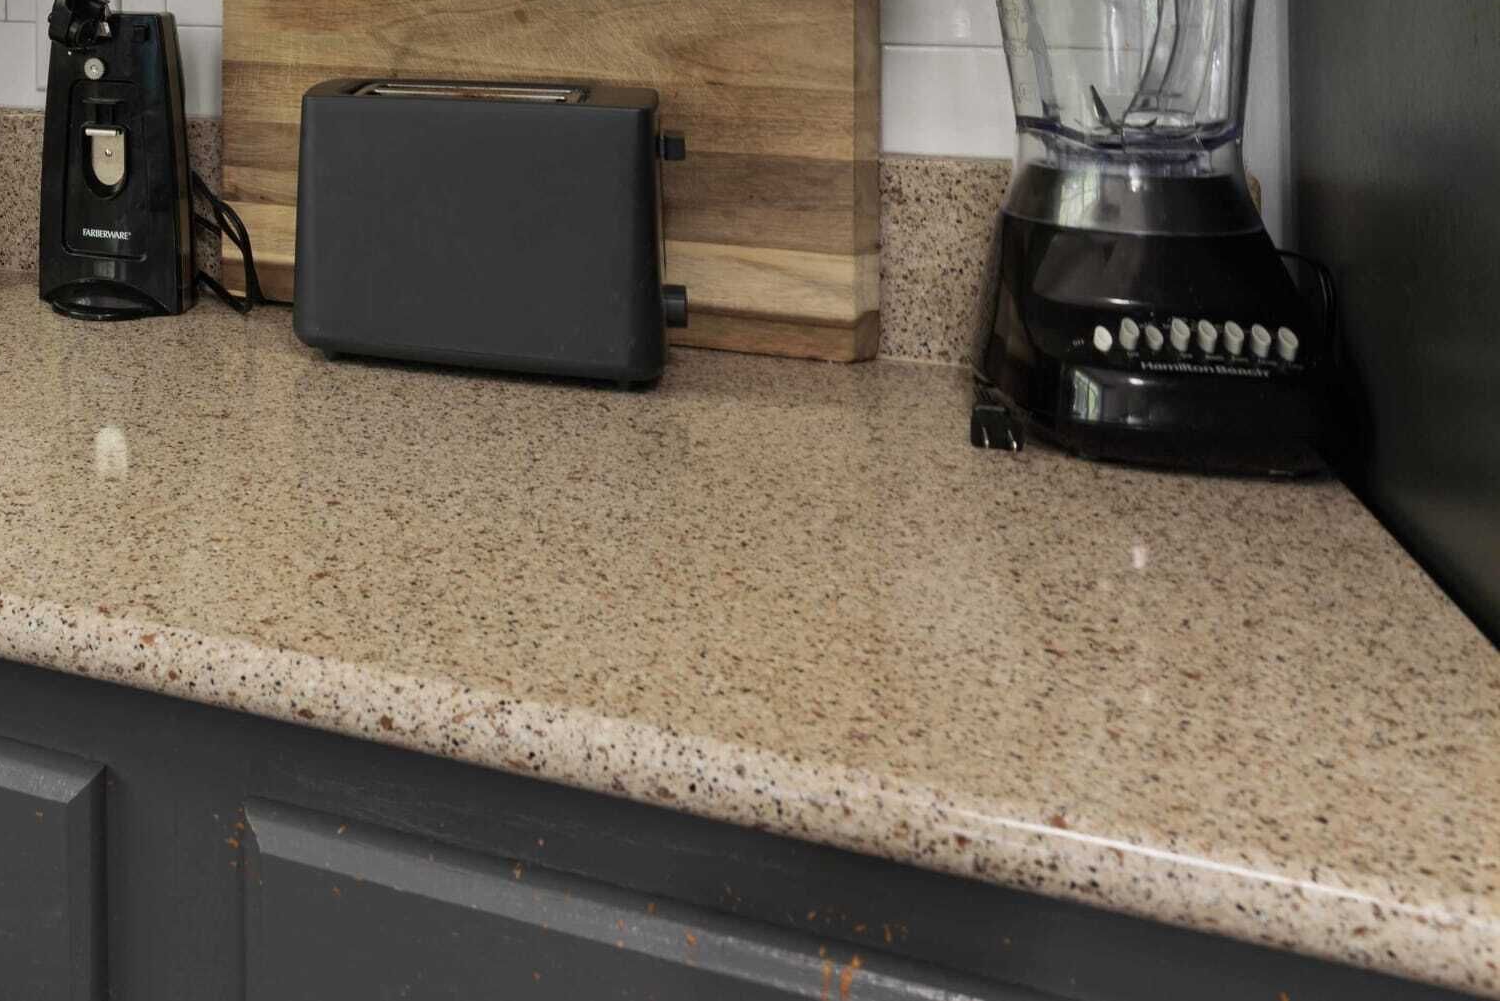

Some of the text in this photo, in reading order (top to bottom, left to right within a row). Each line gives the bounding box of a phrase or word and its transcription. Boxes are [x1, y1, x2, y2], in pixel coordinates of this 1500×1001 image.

[82, 227, 130, 240] FARBERWARE
[1140, 360, 1270, 378] Hamilton Beach
